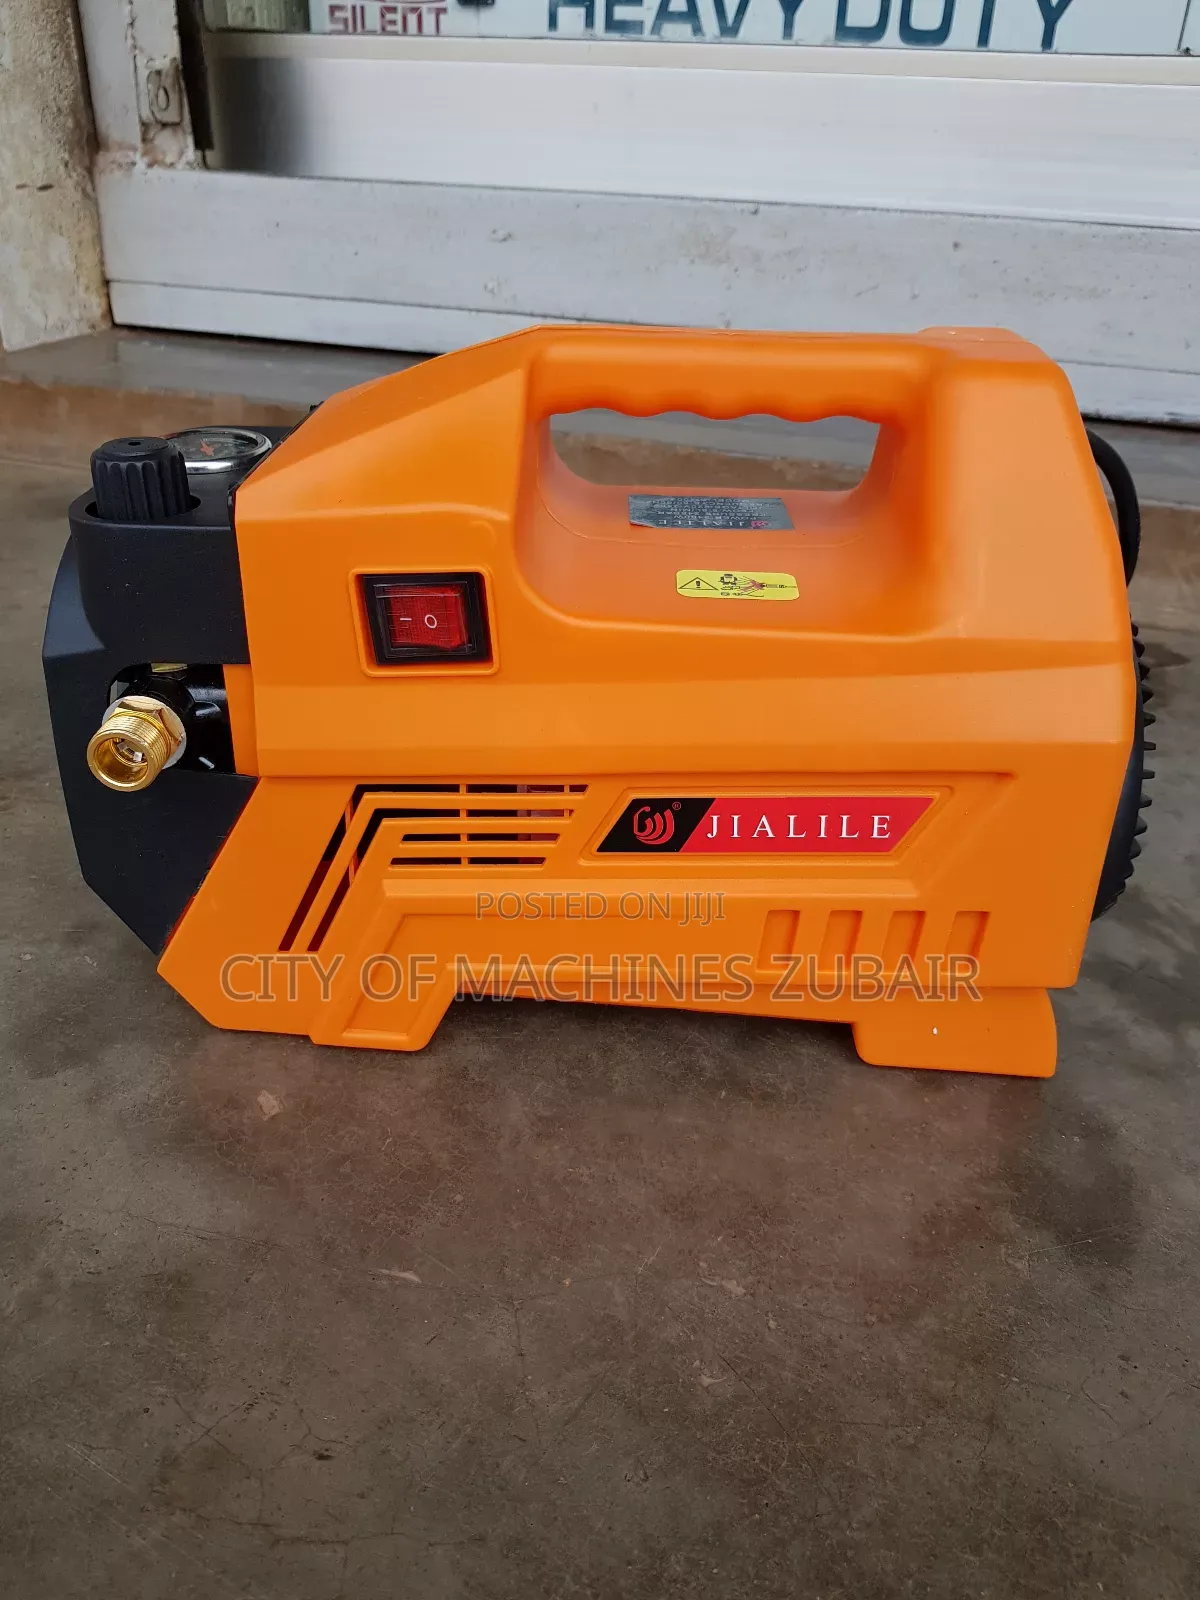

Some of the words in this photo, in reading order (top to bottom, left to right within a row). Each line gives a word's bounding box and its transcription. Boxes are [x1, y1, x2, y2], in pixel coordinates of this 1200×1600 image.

[328, 4, 448, 36] SILENT
[548, 0, 803, 40] HEAVY
[834, 0, 1073, 51] DUTY
[706, 814, 892, 840] JIALILE
